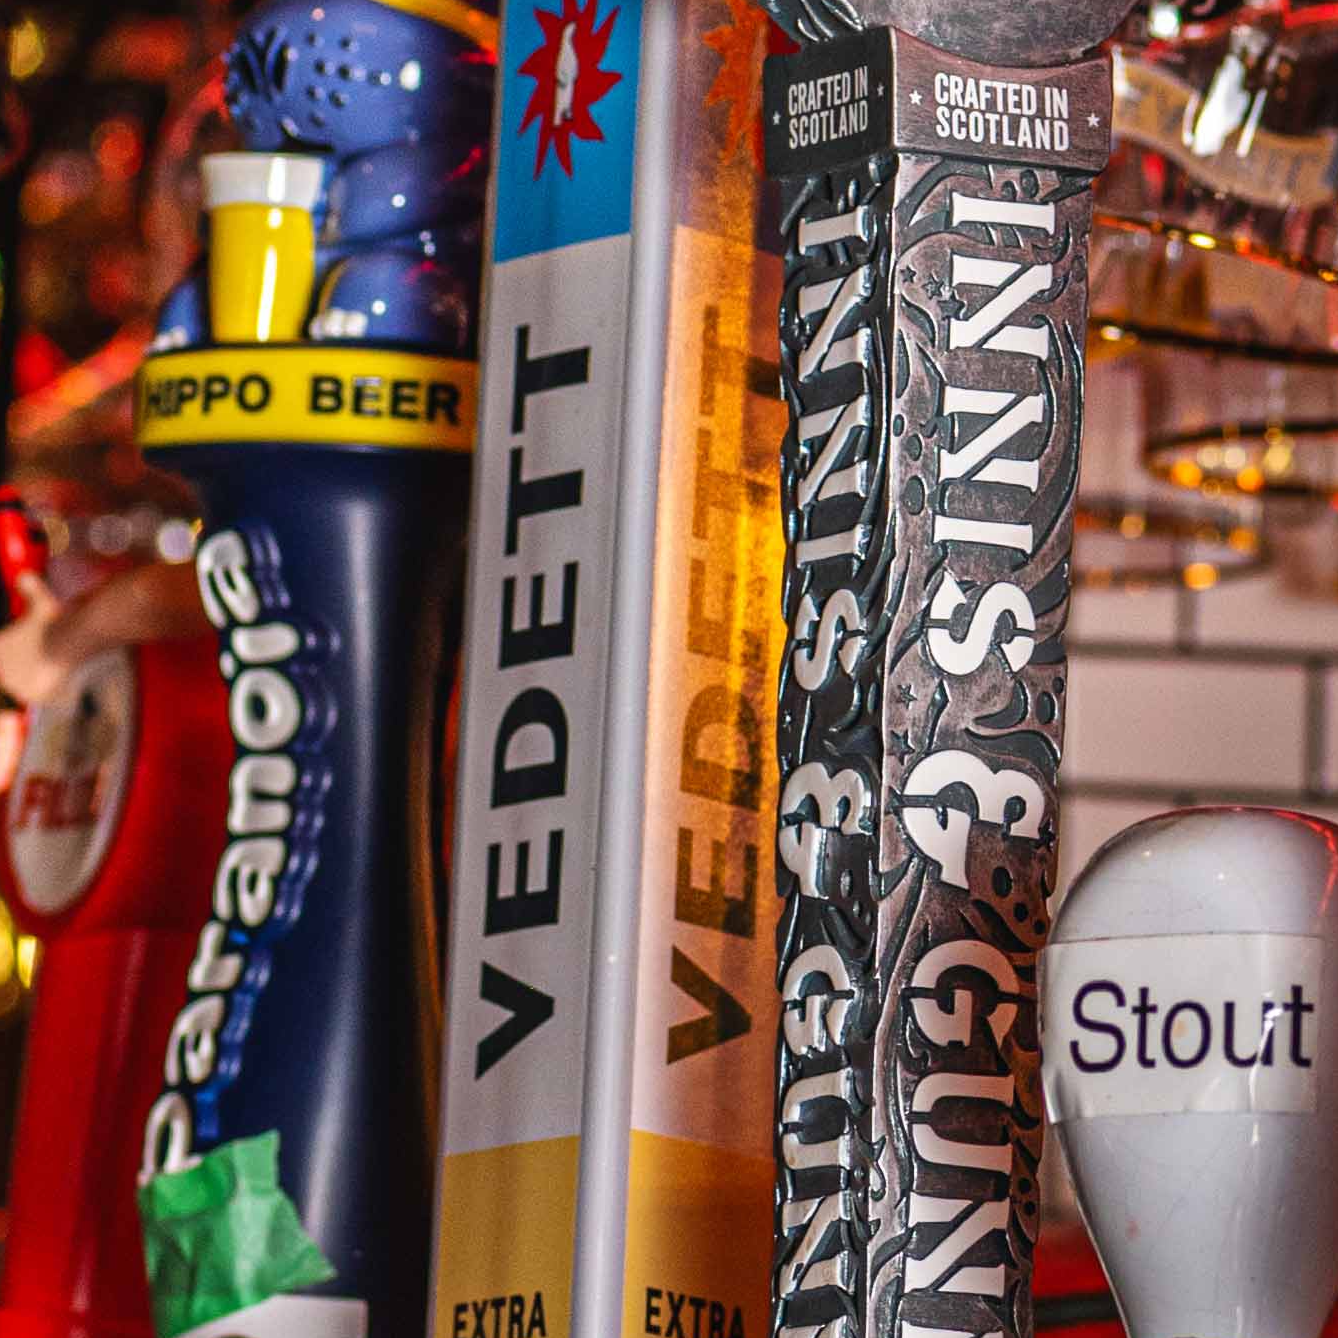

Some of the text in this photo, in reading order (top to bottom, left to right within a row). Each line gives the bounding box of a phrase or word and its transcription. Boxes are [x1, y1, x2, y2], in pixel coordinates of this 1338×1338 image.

[788, 65, 869, 116] CRAFTED IN
[788, 100, 869, 149] SCOTLAND
[934, 73, 1068, 119] CRAFTED IN
[935, 106, 1070, 151] SCOTLAND
[145, 373, 461, 426] HIPPO BEER
[795, 204, 873, 691] INNIS
[925, 191, 1057, 676] INNIS
[475, 324, 592, 1079] VEDETT
[666, 304, 771, 1065] VEDETT
[138, 529, 301, 1188] Paranoia
[902, 748, 1047, 891] &
[1069, 980, 1314, 1073] Stout
